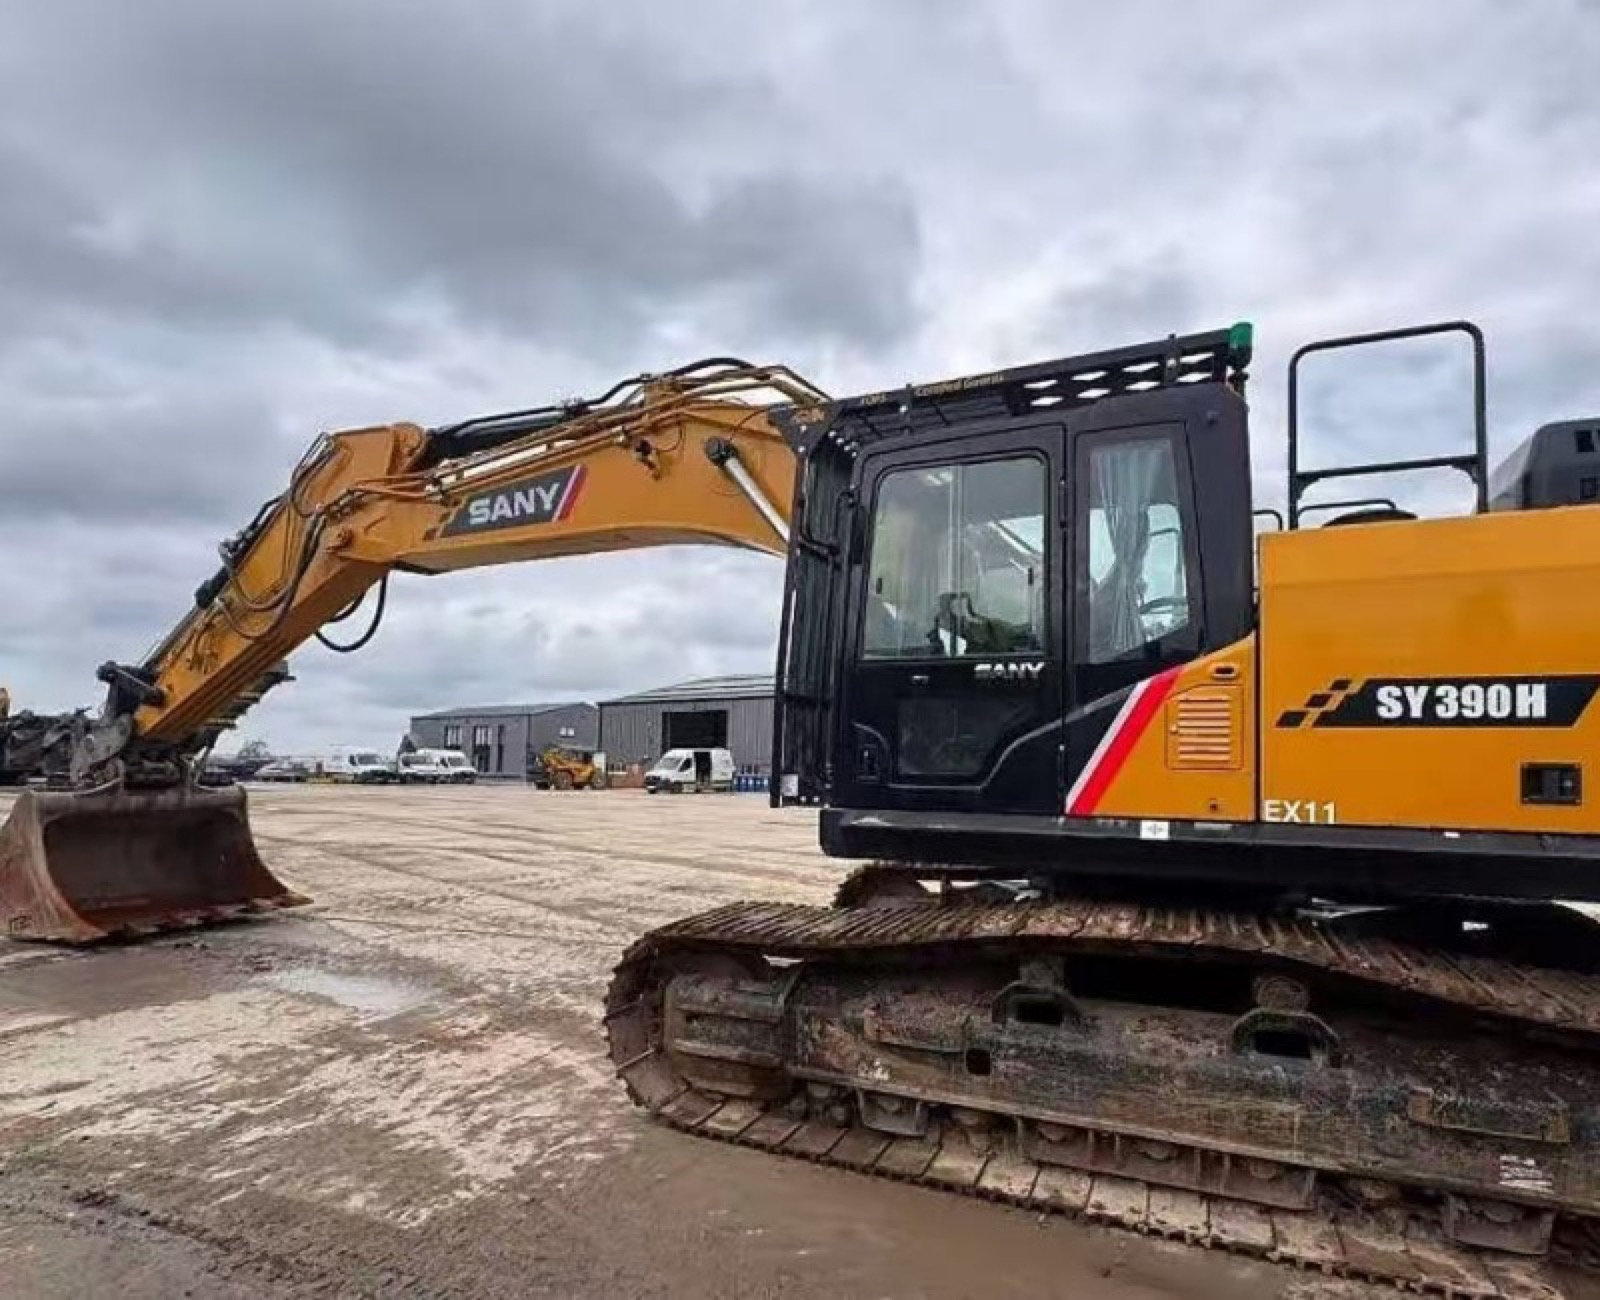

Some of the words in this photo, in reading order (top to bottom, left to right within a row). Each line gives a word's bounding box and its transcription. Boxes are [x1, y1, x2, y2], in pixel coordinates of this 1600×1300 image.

[468, 482, 560, 525] SANY
[974, 662, 1045, 679] SANY
[1263, 800, 1337, 824] EX11
